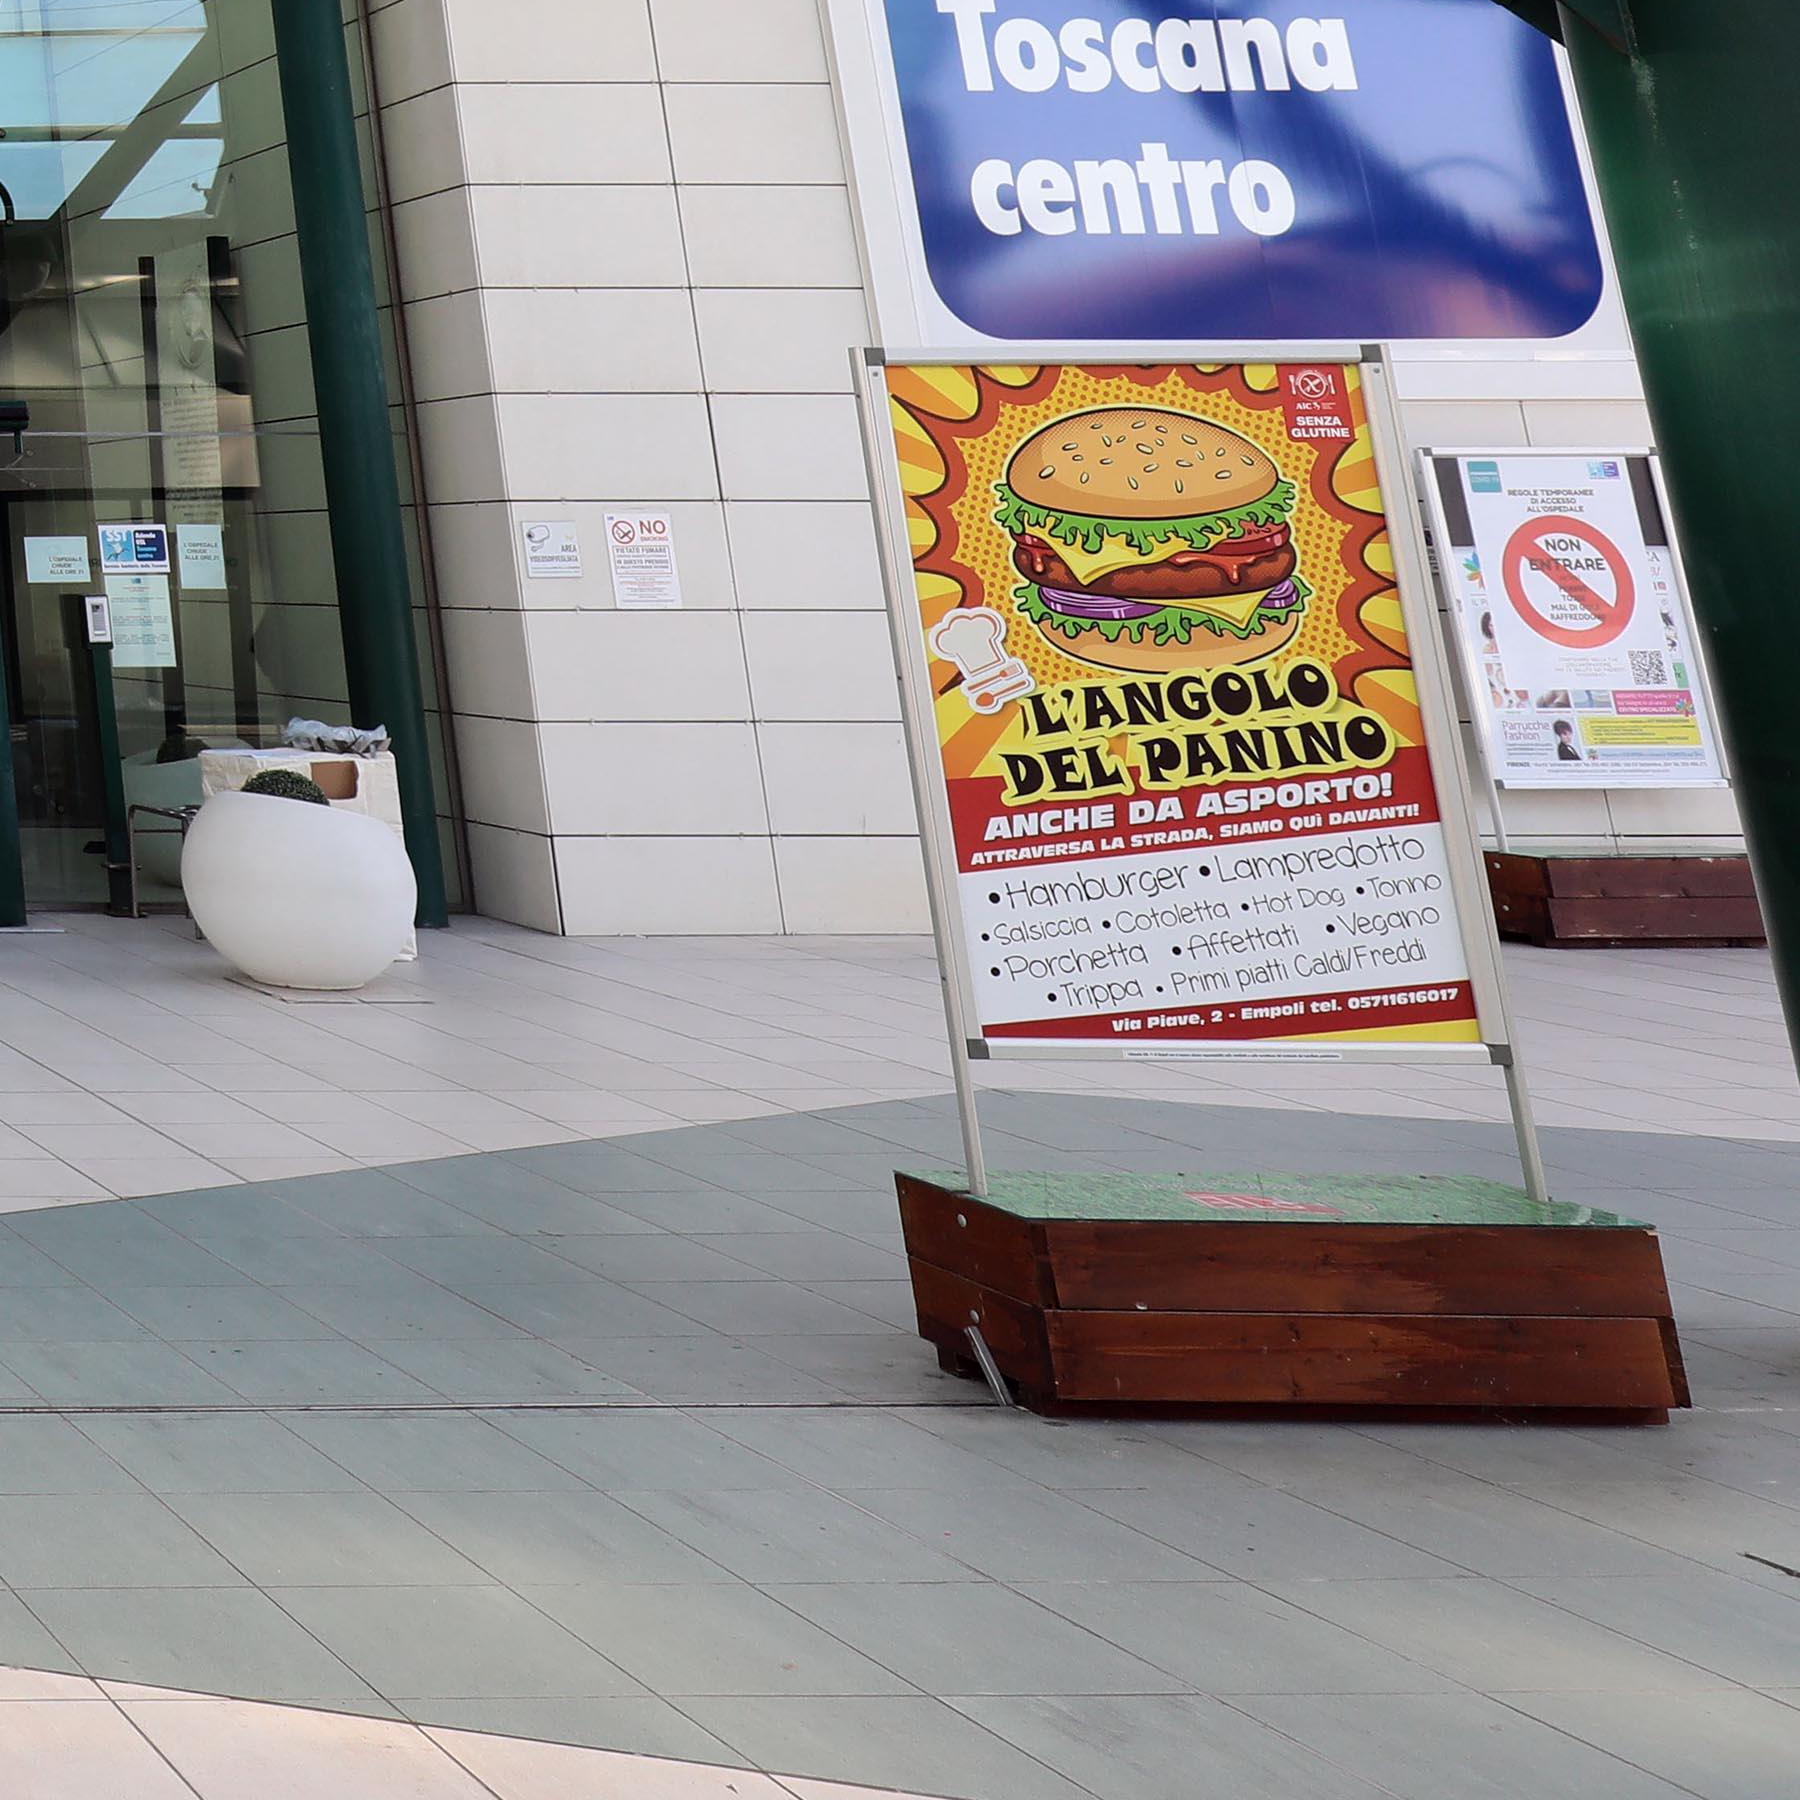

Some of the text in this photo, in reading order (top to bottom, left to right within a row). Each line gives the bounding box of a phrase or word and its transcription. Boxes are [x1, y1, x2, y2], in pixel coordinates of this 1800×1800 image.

[970, 141, 1297, 237] centro
[1291, 428, 1351, 438] GLUTINE
[1296, 416, 1342, 426] SENZA
[105, 530, 127, 543] SST
[639, 520, 666, 534] NO
[1544, 539, 1581, 551] NON
[1529, 558, 1606, 571] ENTRARE
[1024, 662, 1331, 737] L'ANGOLO
[1502, 720, 1550, 732] Parrucche
[1002, 714, 1388, 799] DEL PANINO
[1504, 730, 1540, 741] fashion
[984, 773, 1393, 841] ANCHE DA ASPORTO!
[970, 839, 1095, 865] ATTRAVERSA
[1100, 835, 1125, 851] LA
[1129, 826, 1214, 849] STRADA,
[1219, 819, 1283, 839] SIAMO
[1328, 803, 1420, 827] DAVANTI!
[1006, 834, 1426, 909] Hamburger Lampredotto
[993, 872, 1443, 946] Salsiccia Cotoletta Hot Dog Tonno
[1004, 906, 1440, 981] Porchetta Affettati Vegano
[1060, 938, 1428, 1009] Trippa Primi piatti Caldi/Freddi
[1112, 1016, 1143, 1032] Via
[1147, 1011, 1205, 1029] Piave,
[1211, 1010, 1222, 1022] 2
[1241, 1001, 1305, 1021] Empoli
[1310, 998, 1341, 1013] tel.
[1347, 988, 1459, 1010] 05711616017
